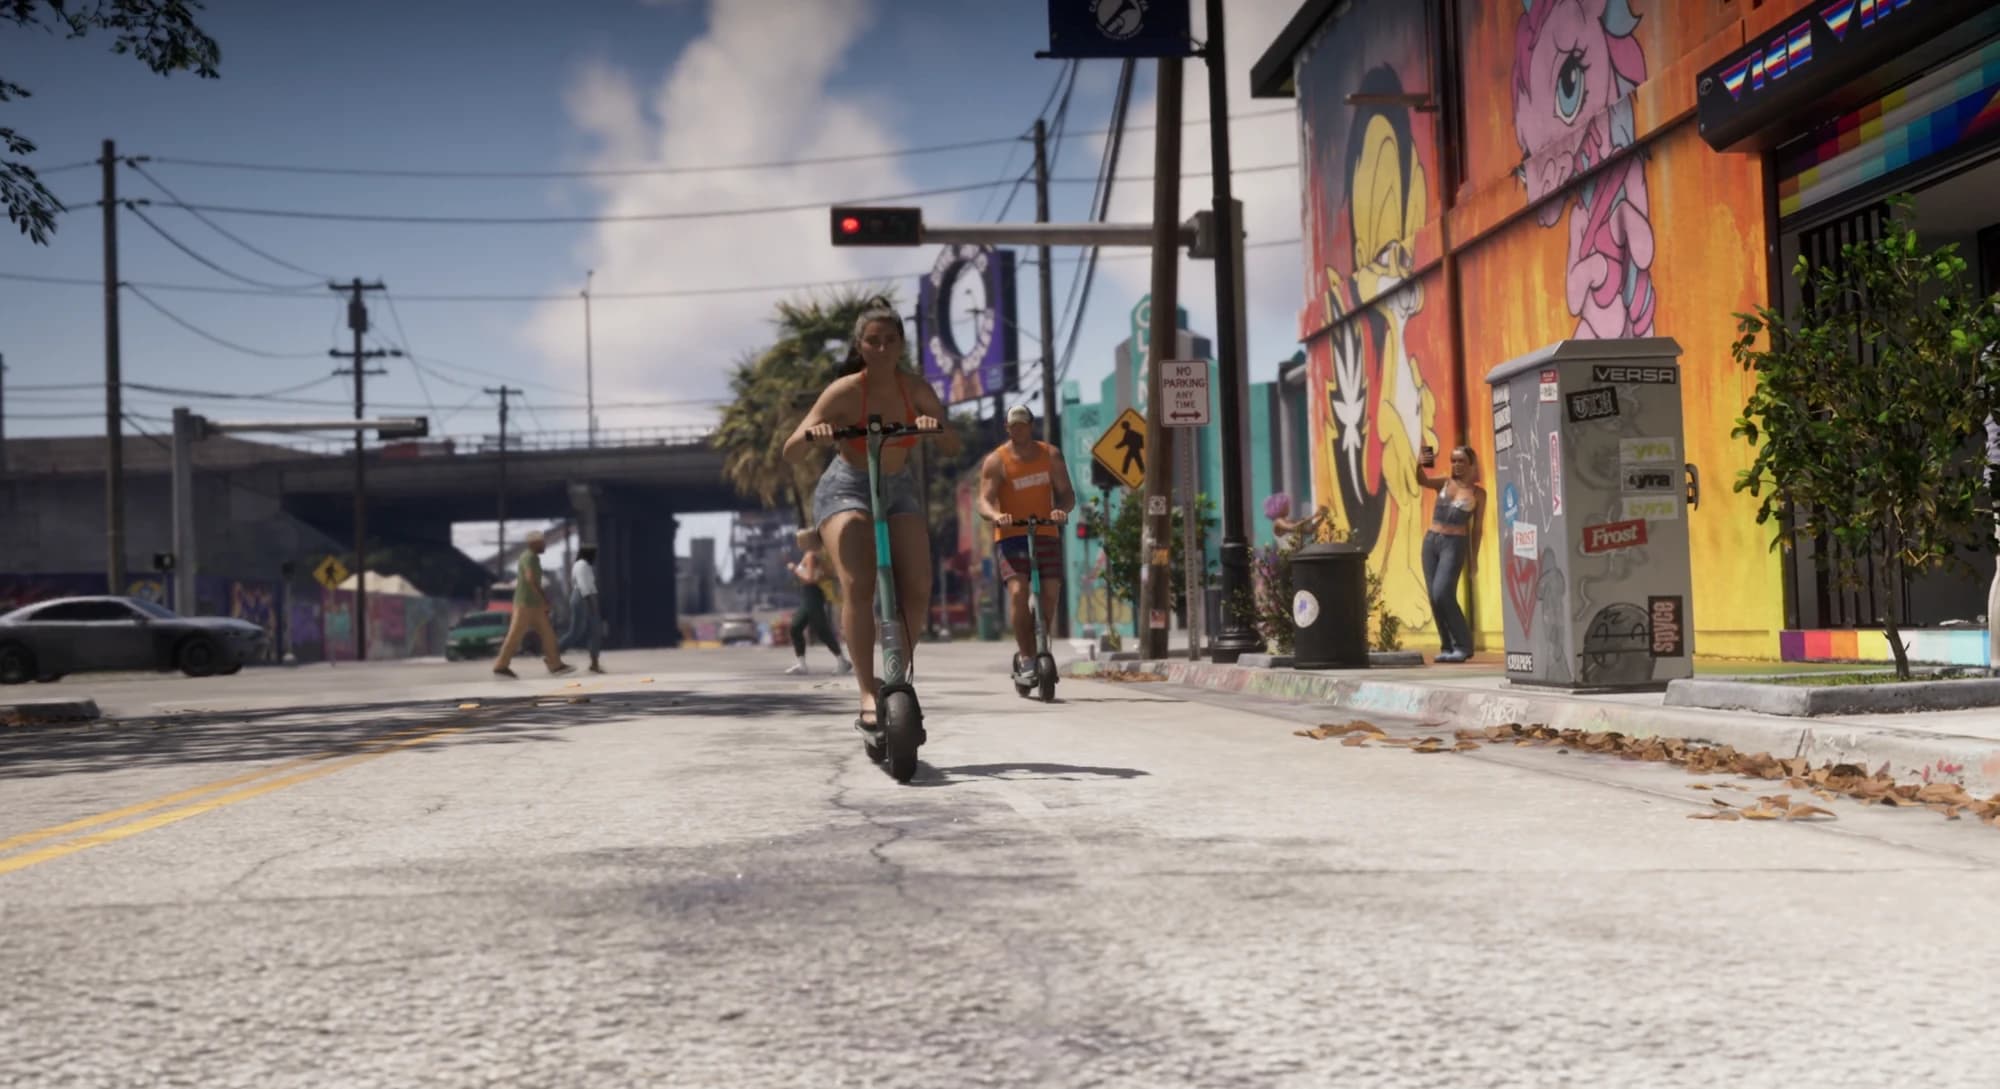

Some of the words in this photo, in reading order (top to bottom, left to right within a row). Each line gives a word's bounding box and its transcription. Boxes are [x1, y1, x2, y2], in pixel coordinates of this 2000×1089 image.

[1719, 19, 1813, 102] VICE
[1175, 366, 1192, 376] NO
[1595, 367, 1674, 383] VERSA
[1163, 378, 1207, 388] PARKING
[1175, 391, 1193, 399] ANY
[1175, 400, 1196, 408] TIME
[1591, 524, 1639, 548] Frost
